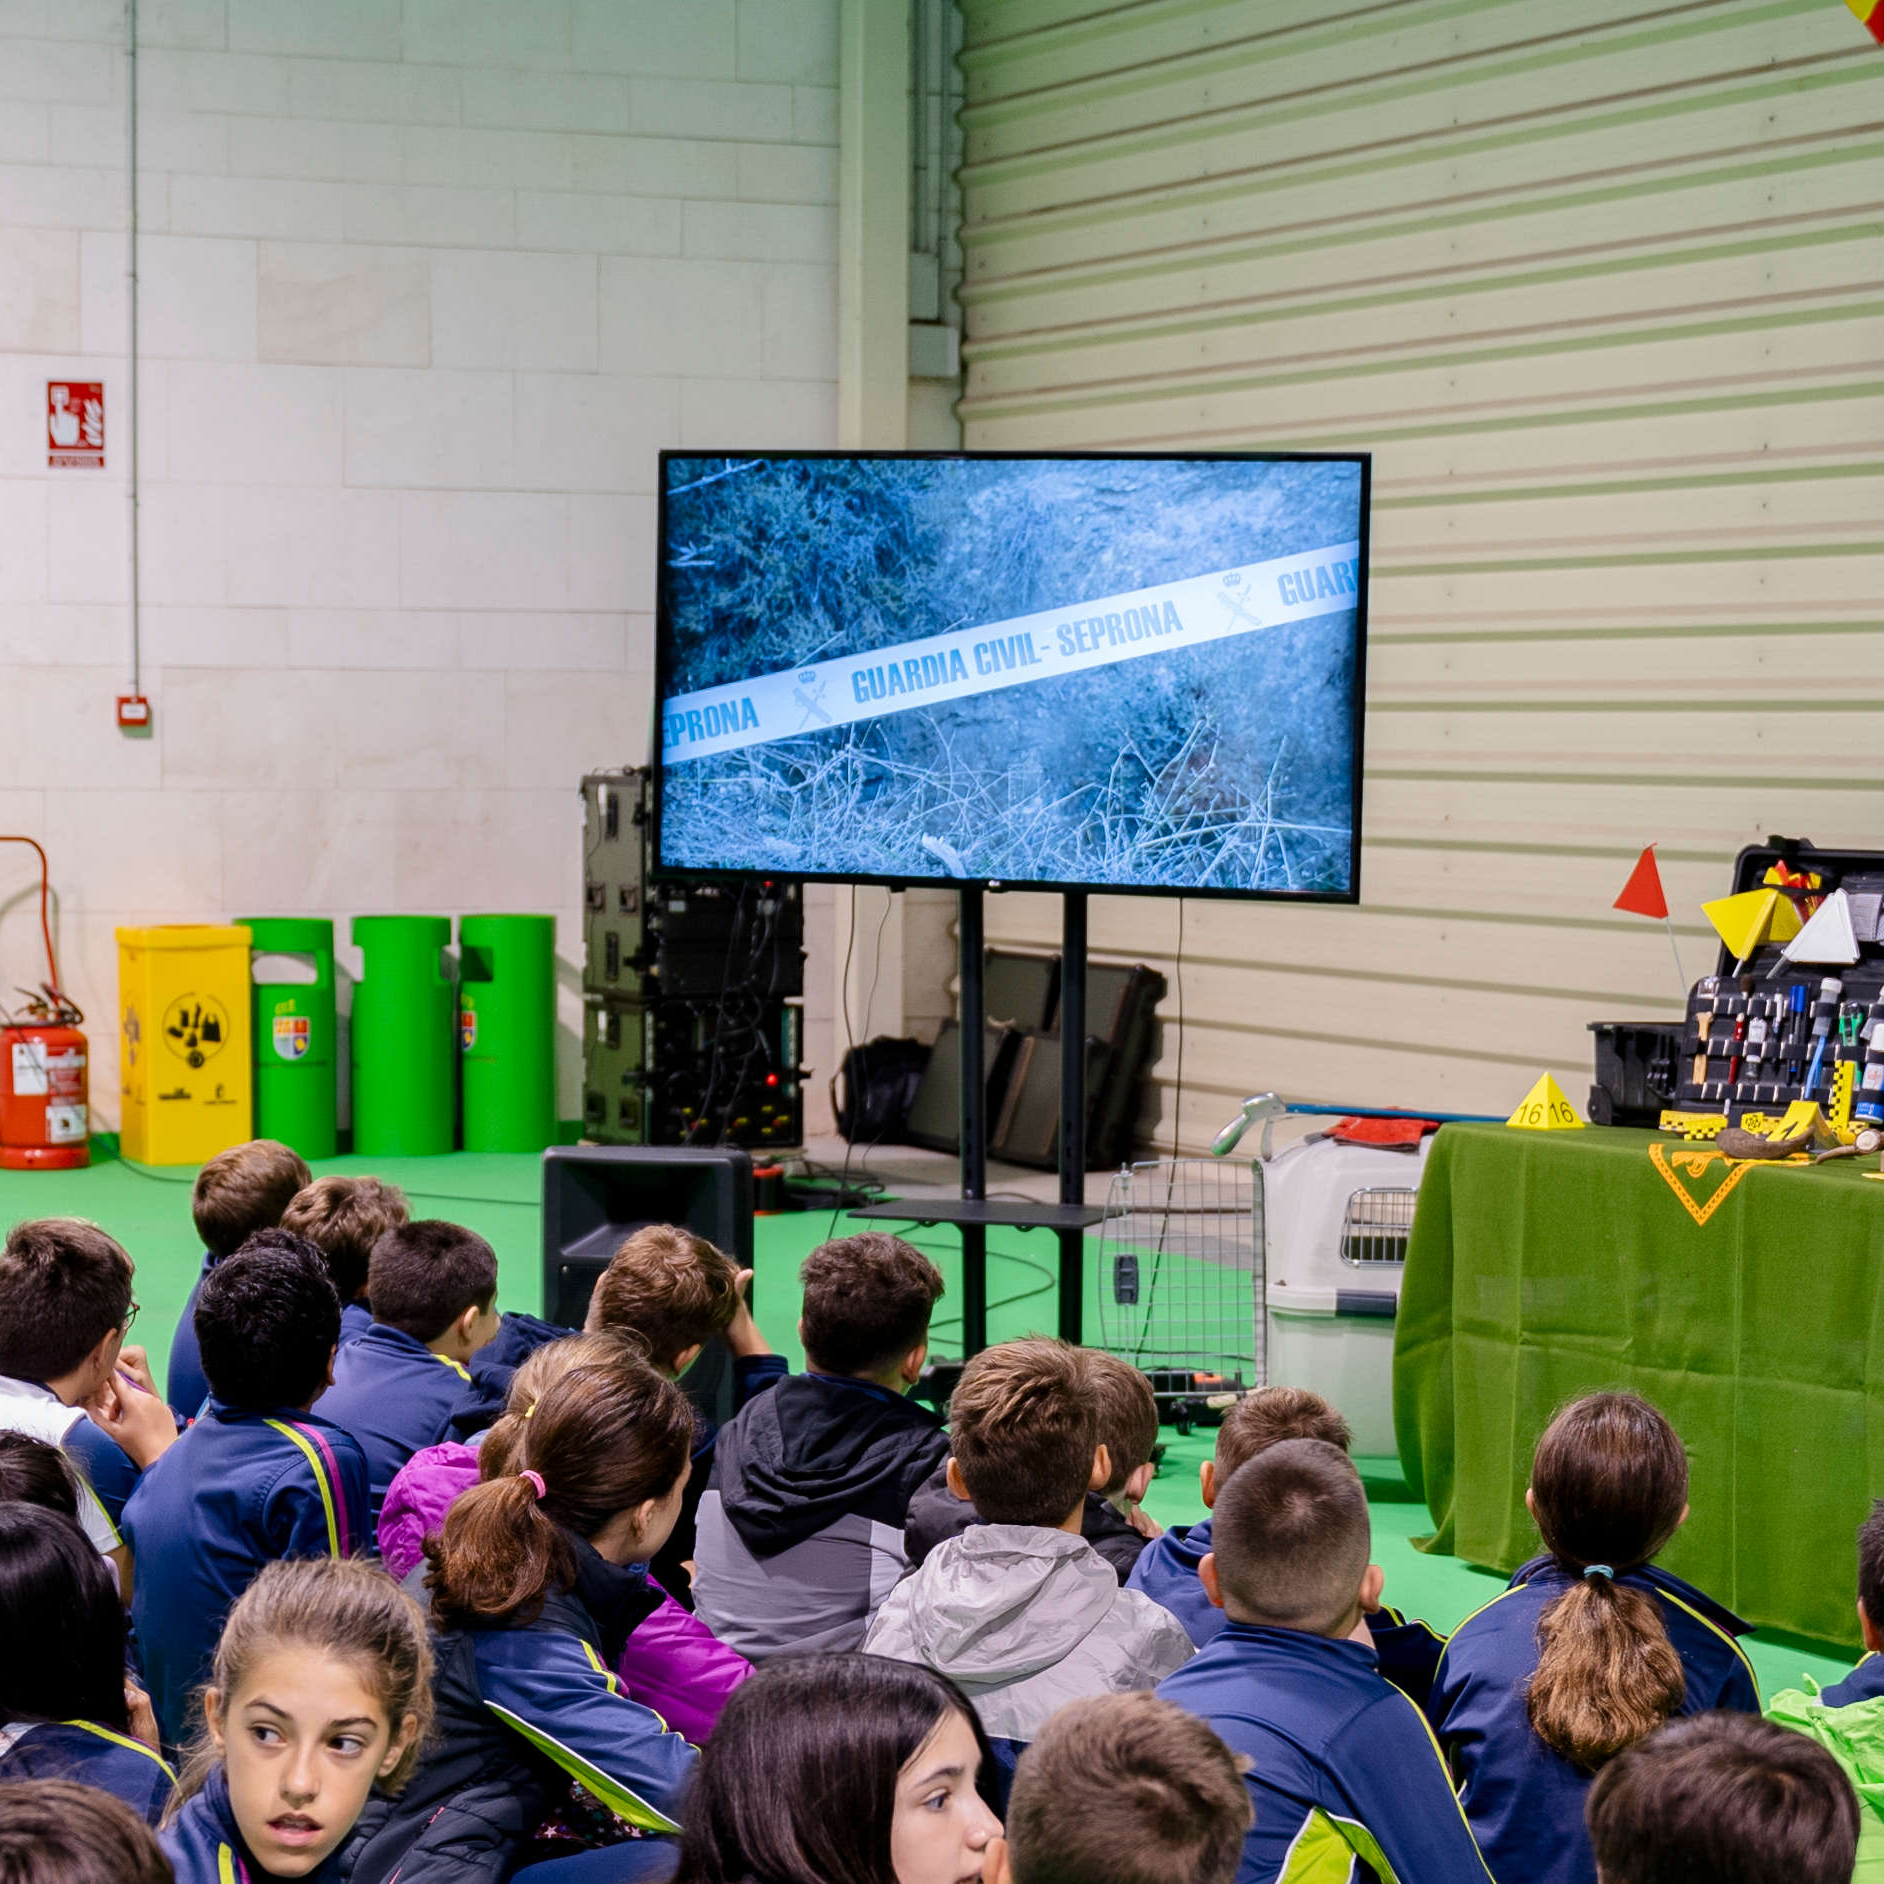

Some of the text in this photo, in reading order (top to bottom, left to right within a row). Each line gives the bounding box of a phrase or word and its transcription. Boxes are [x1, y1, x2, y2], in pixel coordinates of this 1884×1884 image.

[851, 648, 969, 704] GUARDIA
[1056, 600, 1184, 657] SEPRONA
[1519, 1103, 1544, 1125] 16
[1549, 1101, 1574, 1123] 16
